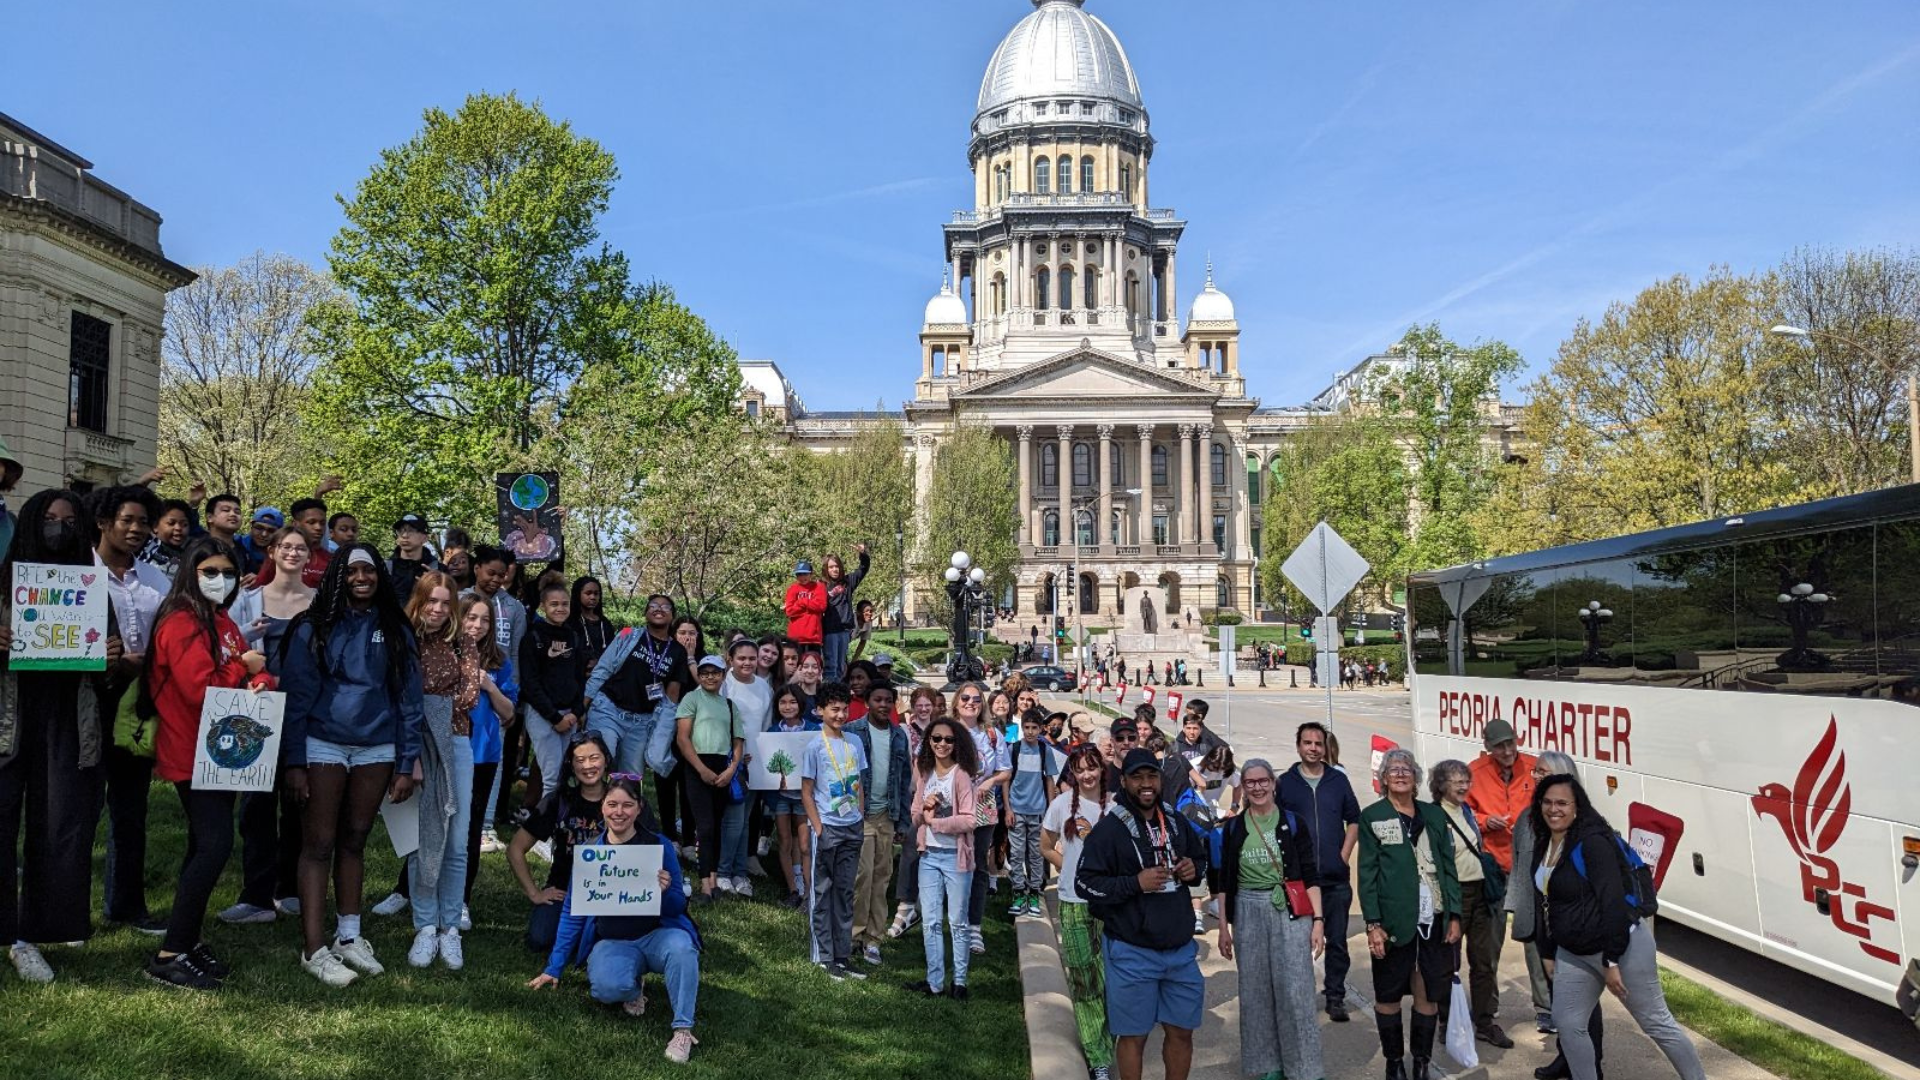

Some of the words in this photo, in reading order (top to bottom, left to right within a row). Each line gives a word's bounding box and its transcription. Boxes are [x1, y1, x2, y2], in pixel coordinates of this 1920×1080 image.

[15, 585, 88, 607] CHANGE
[18, 624, 32, 638] to
[31, 623, 81, 649] SEE
[551, 640, 568, 651] NIKE
[214, 690, 269, 721] SAVE
[1513, 696, 1632, 766] CHARTER
[198, 761, 224, 785] THE
[230, 764, 274, 787] EARTH
[1639, 836, 1654, 848] NO
[598, 880, 607, 888] in
[618, 889, 654, 905] Hands
